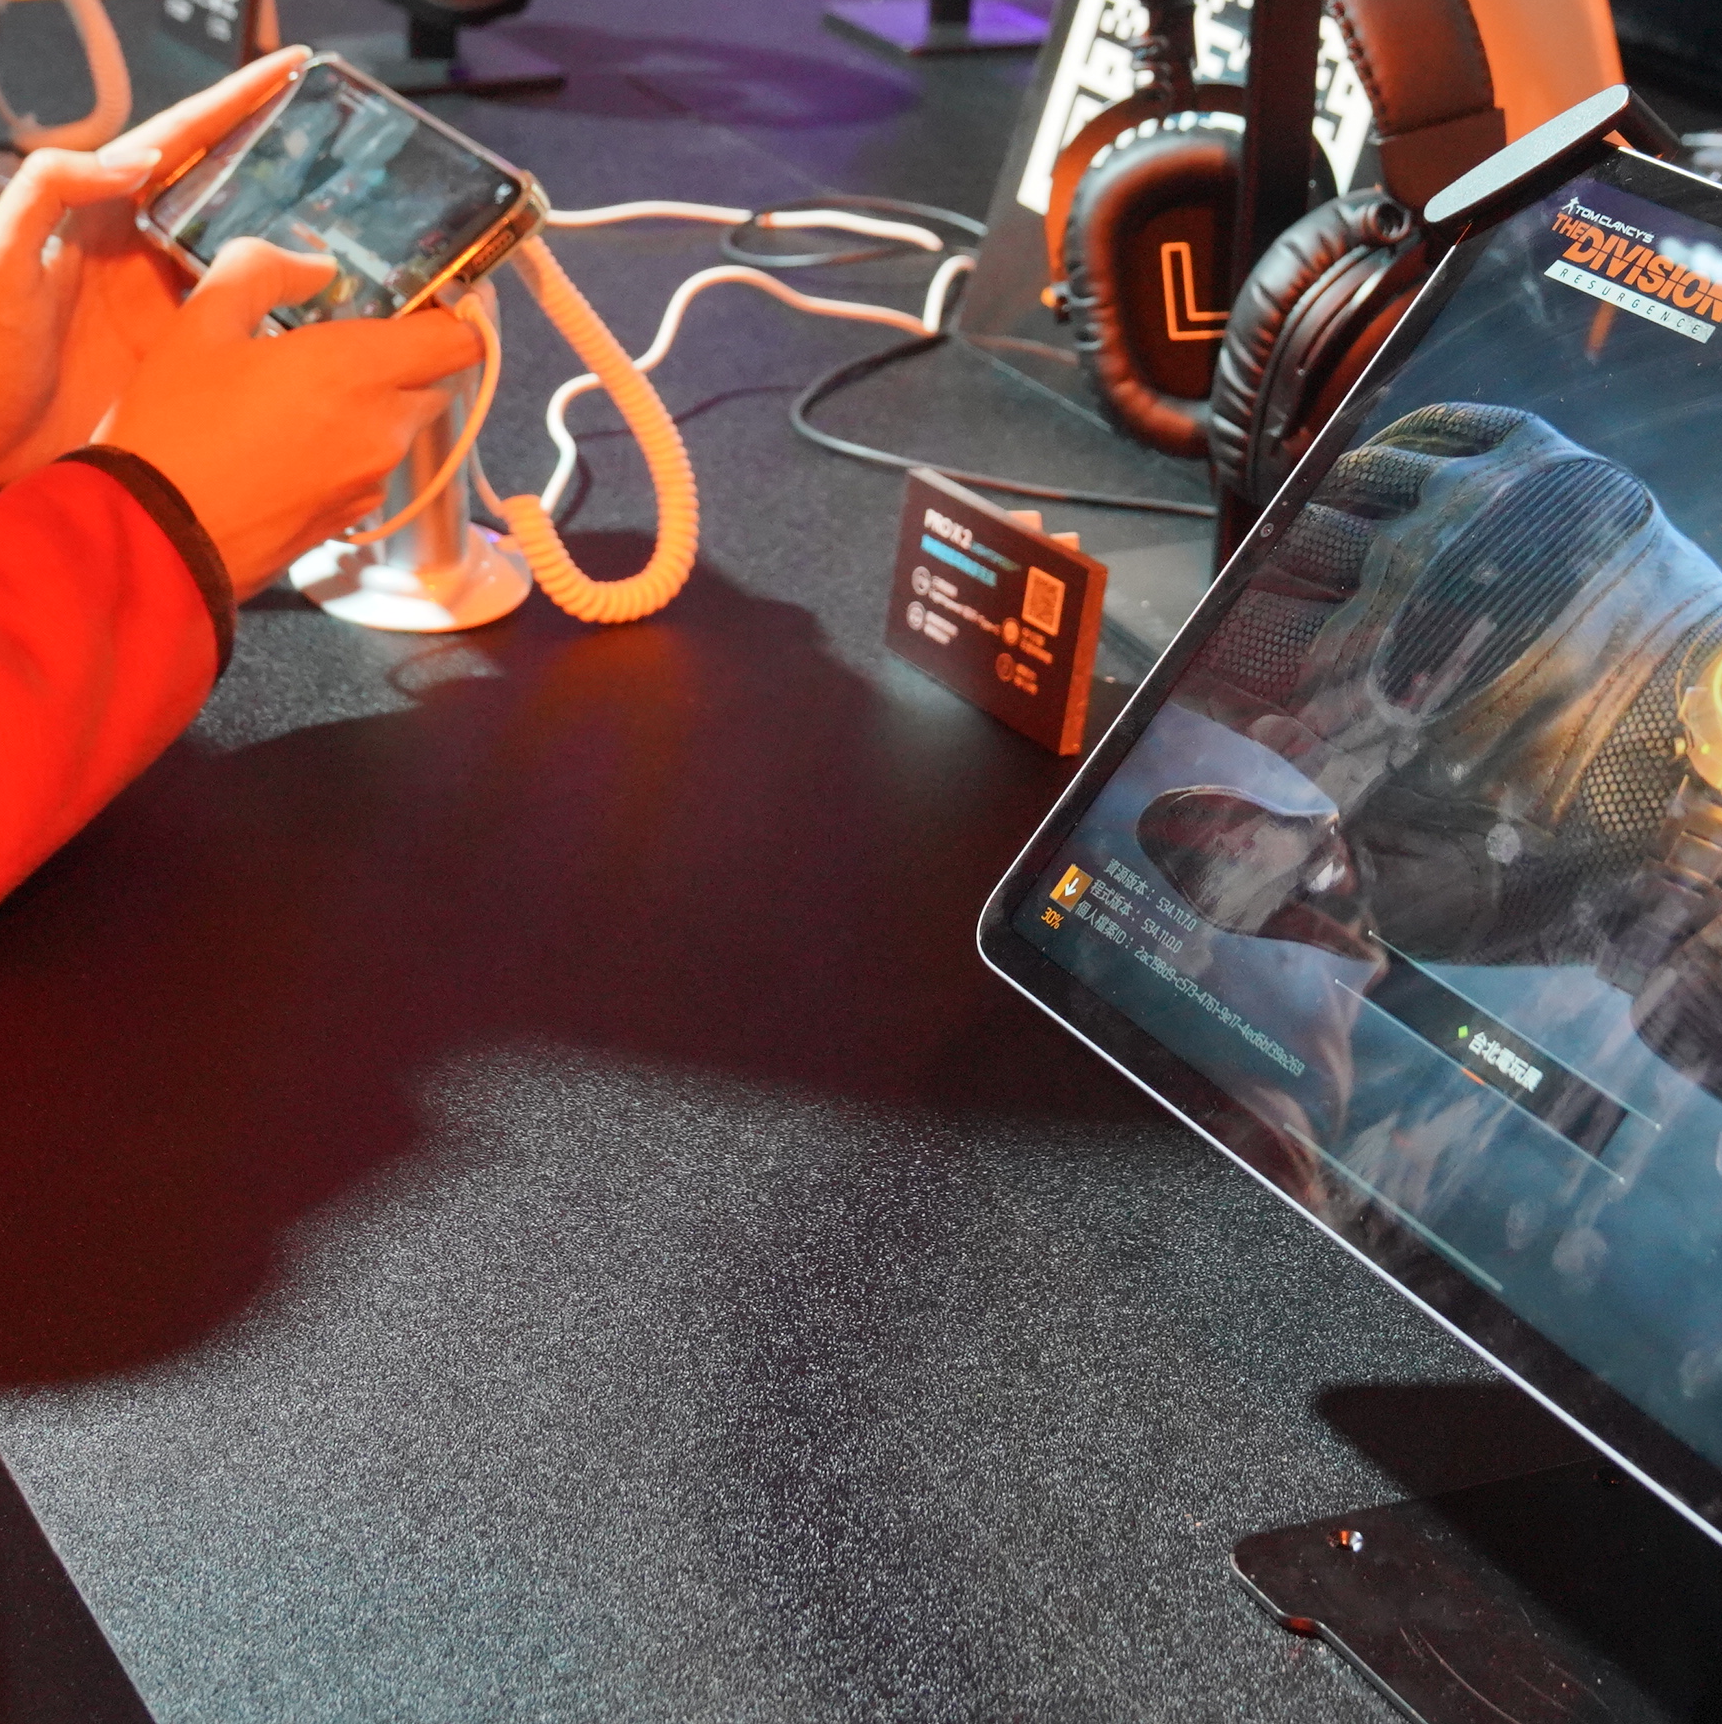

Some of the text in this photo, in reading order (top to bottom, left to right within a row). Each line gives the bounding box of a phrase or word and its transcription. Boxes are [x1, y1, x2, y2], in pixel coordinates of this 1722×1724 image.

[1551, 213, 1587, 241] THE
[1575, 204, 1655, 244] TOM CLANCY'S
[1560, 268, 1701, 335] RESURGENCE
[1040, 907, 1065, 930] 30%
